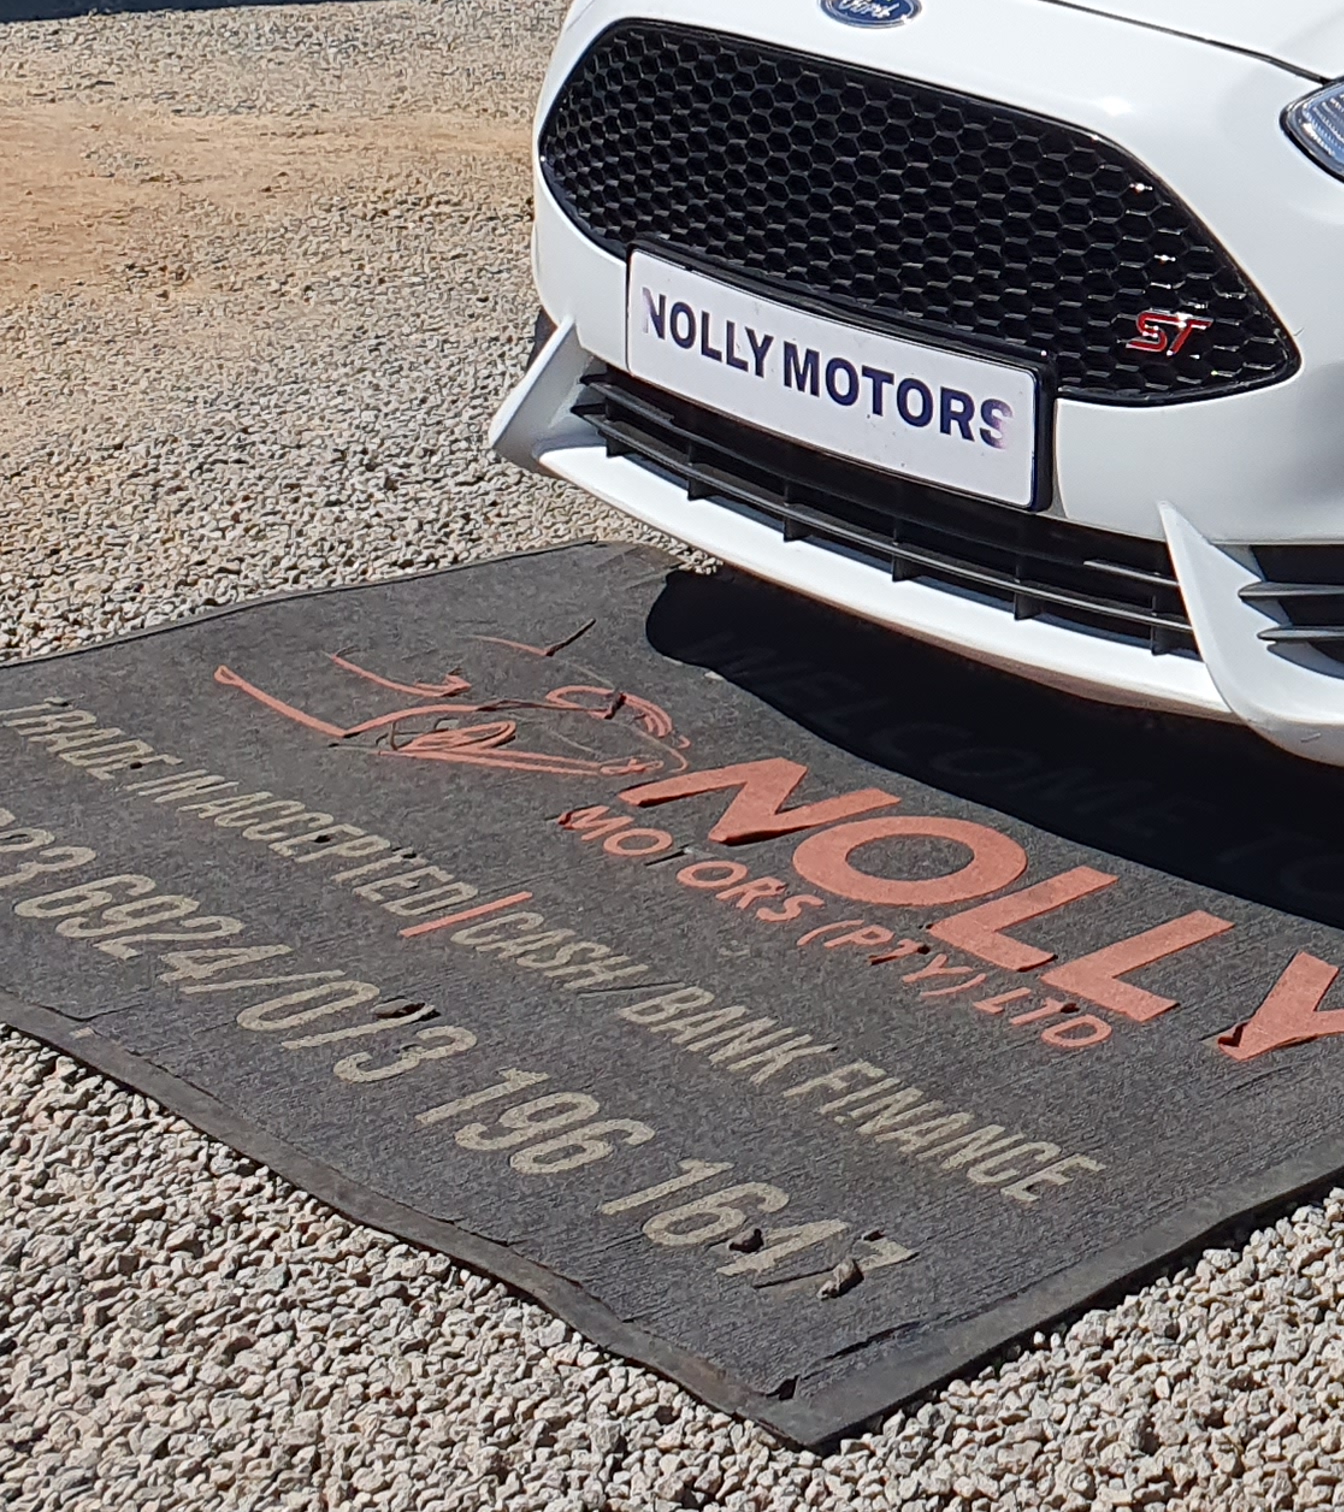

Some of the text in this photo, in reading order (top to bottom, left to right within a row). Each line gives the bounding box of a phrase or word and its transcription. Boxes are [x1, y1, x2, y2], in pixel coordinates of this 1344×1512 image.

[642, 287, 1014, 451] NOLLY MOTORS
[1126, 309, 1214, 357] ST
[0, 696, 184, 781] TRADE
[783, 1058, 1107, 1204] FINANCE
[557, 804, 826, 923] MOORS
[973, 986, 1113, 1048] LTD
[415, 1066, 656, 1175] 196
